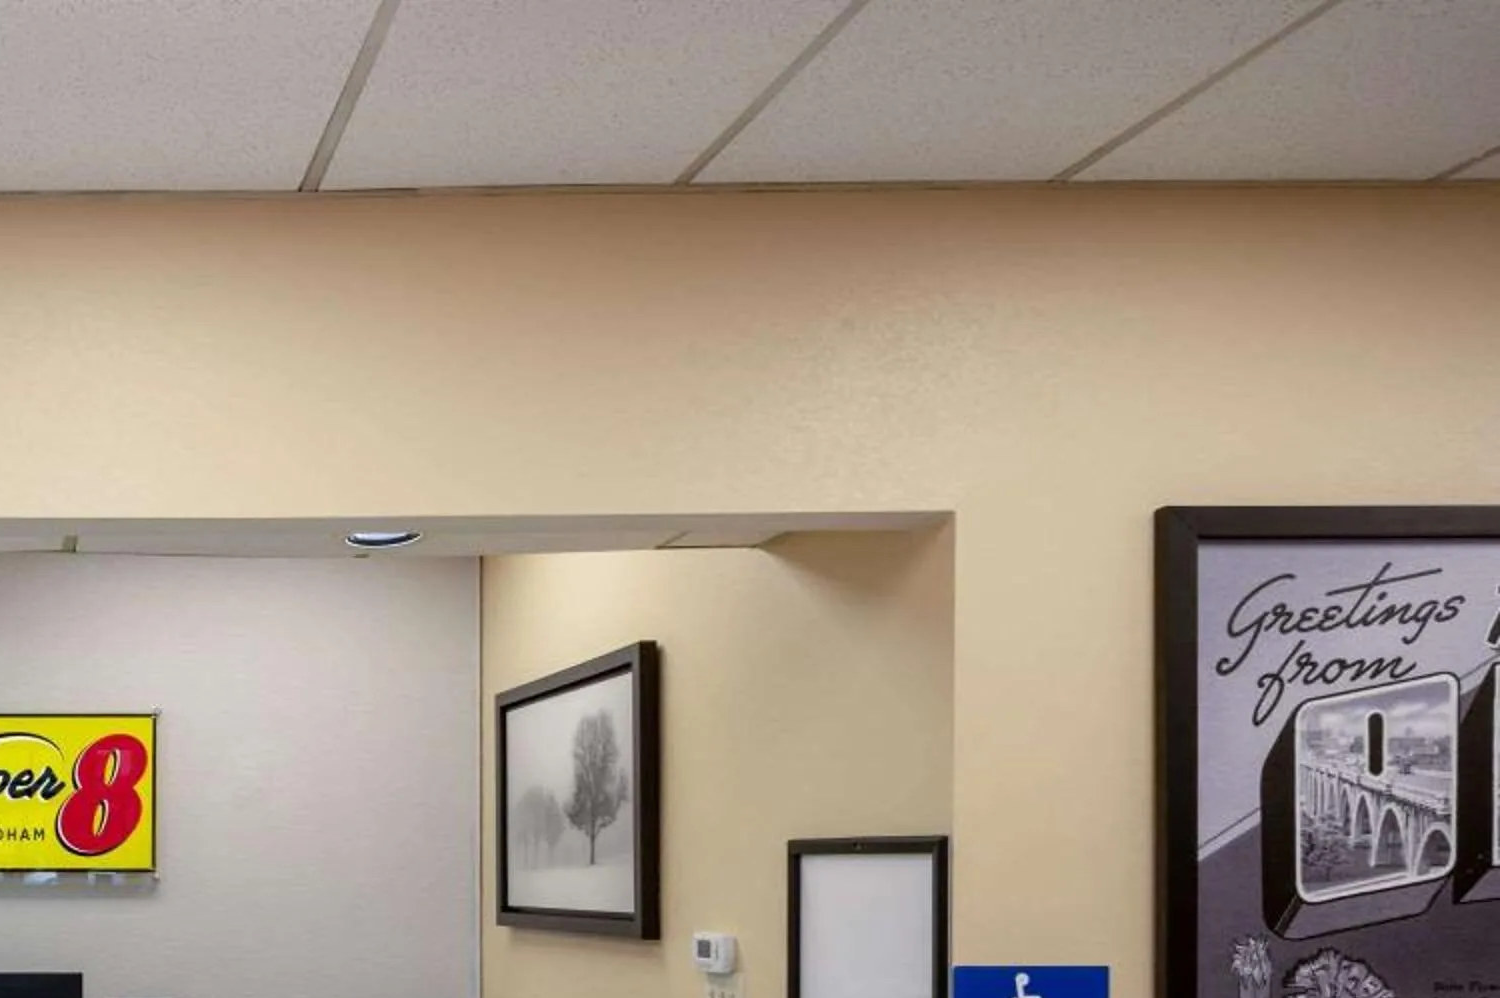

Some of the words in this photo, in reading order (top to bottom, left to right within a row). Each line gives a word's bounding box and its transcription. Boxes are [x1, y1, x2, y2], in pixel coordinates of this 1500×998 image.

[1215, 561, 1466, 676] Greetings
[1252, 640, 1416, 726] from
[56, 733, 149, 857] 8
